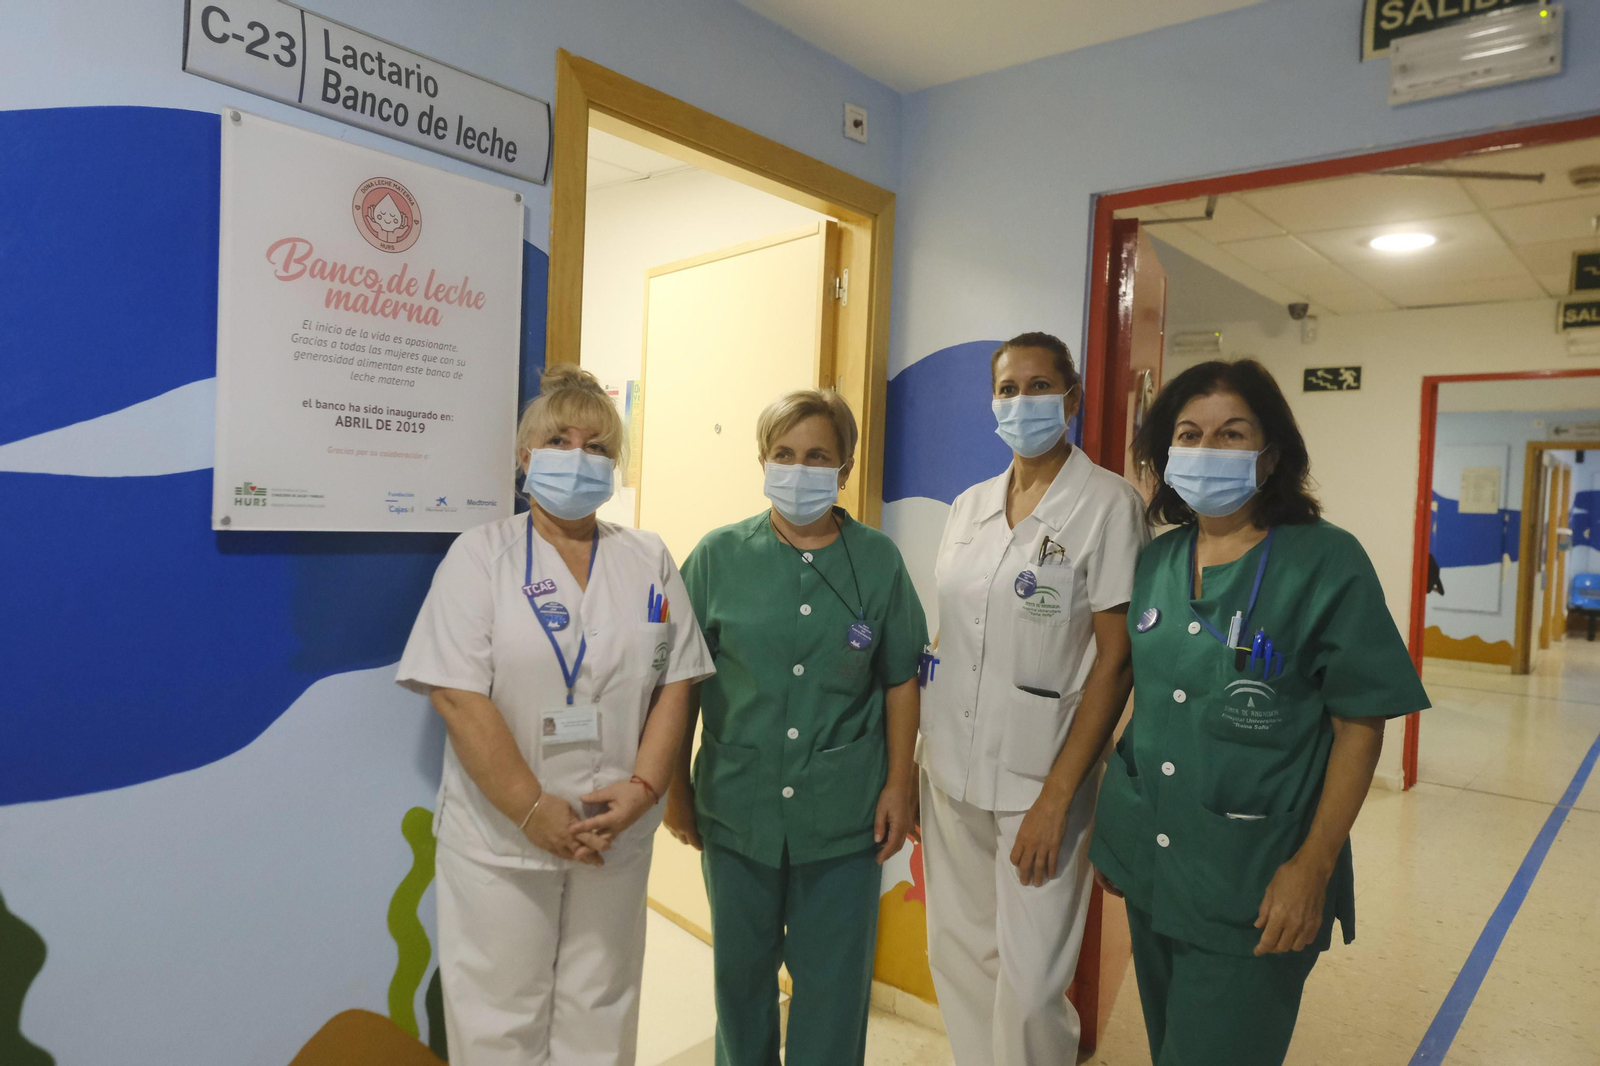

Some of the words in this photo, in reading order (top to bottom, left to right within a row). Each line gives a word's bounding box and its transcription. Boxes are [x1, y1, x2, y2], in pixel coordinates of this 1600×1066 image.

[201, 5, 297, 68] C-23
[323, 28, 439, 98] Lactario
[321, 67, 409, 127] Banco
[417, 104, 448, 140] de
[455, 115, 518, 163] leche
[360, 182, 375, 194] DONA
[374, 180, 392, 188] LECHE
[392, 183, 415, 206] MATERNA
[265, 237, 383, 289] Banco
[386, 263, 420, 297] de
[423, 269, 486, 310] leche
[324, 284, 443, 327] materna
[302, 319, 312, 330] El
[315, 321, 342, 335] inicio
[345, 326, 357, 337] de
[359, 328, 369, 339] la
[371, 331, 390, 342] vida
[393, 335, 403, 344] es
[405, 338, 459, 353] apasionante.
[291, 332, 328, 348] Gracias
[330, 341, 337, 349] a
[340, 341, 366, 353] todas
[368, 344, 382, 355] las
[384, 348, 420, 360] mujeres
[421, 354, 438, 363] que
[440, 356, 454, 365] con
[456, 359, 466, 367] su
[293, 350, 355, 366] generosidad
[356, 357, 403, 372] alimentan
[405, 365, 424, 375] este
[425, 367, 451, 378] banco
[453, 370, 464, 380] de
[350, 371, 376, 383] leche
[377, 376, 416, 388] materna
[302, 398, 312, 408] el
[315, 399, 346, 411] banco
[348, 402, 361, 412] ha
[363, 404, 384, 415] sido
[386, 406, 438, 420] inaugurado
[440, 413, 455, 422] en:
[334, 415, 373, 430] ABRIL
[375, 418, 392, 431] DE
[396, 420, 426, 434] 2019
[327, 446, 354, 456] Gracias
[355, 448, 368, 458] por
[234, 497, 267, 507] HURS
[388, 504, 415, 514] Cajasol
[466, 499, 498, 507] Medtronic
[522, 580, 556, 596] TCAE
